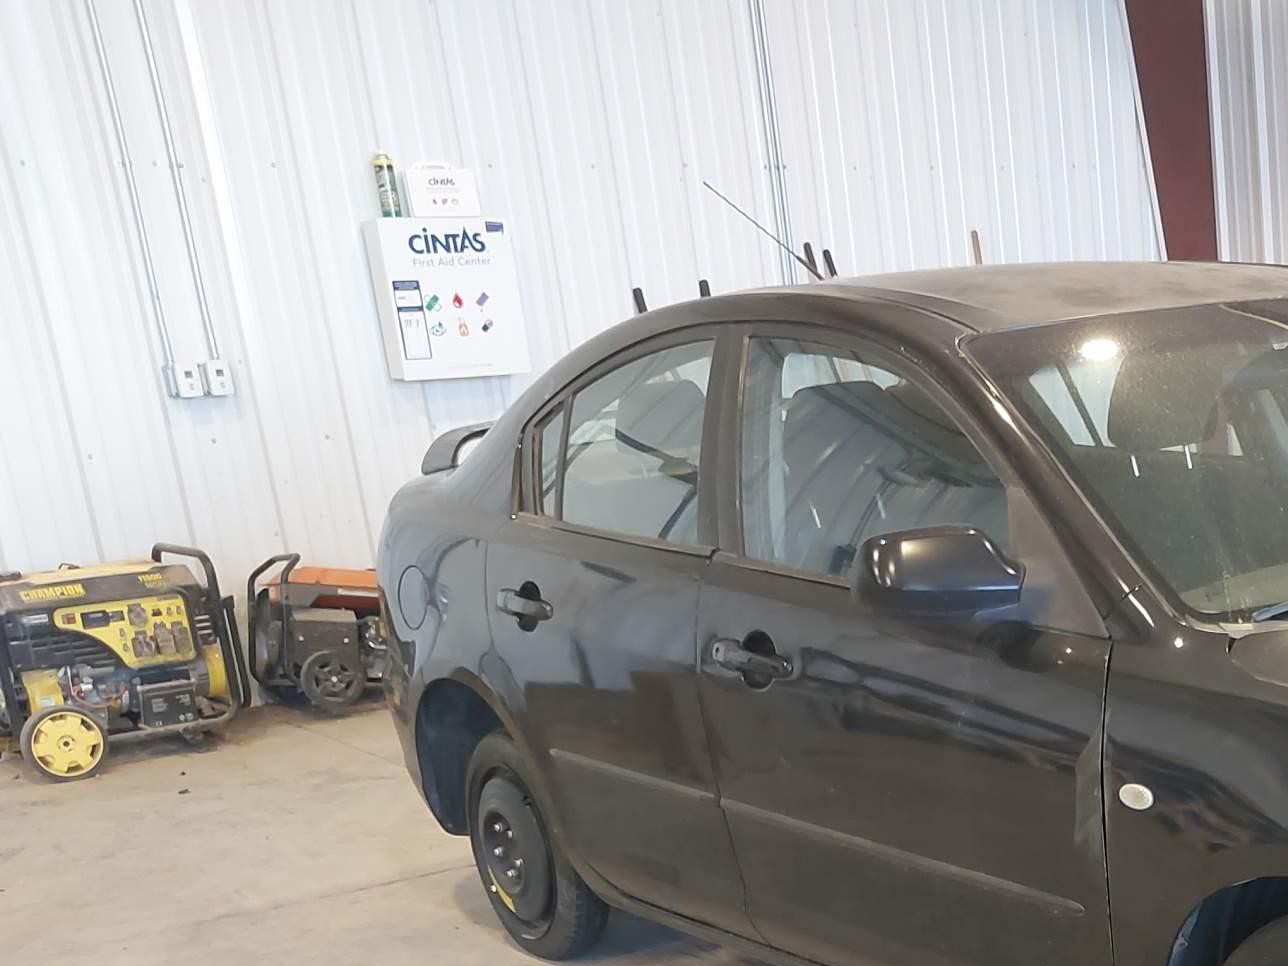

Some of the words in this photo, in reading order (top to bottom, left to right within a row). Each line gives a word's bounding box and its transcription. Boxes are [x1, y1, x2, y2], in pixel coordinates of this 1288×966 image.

[412, 258, 435, 267] First
[438, 256, 454, 266] Aid
[457, 256, 490, 266] Center
[19, 584, 86, 602] CHAMPION
